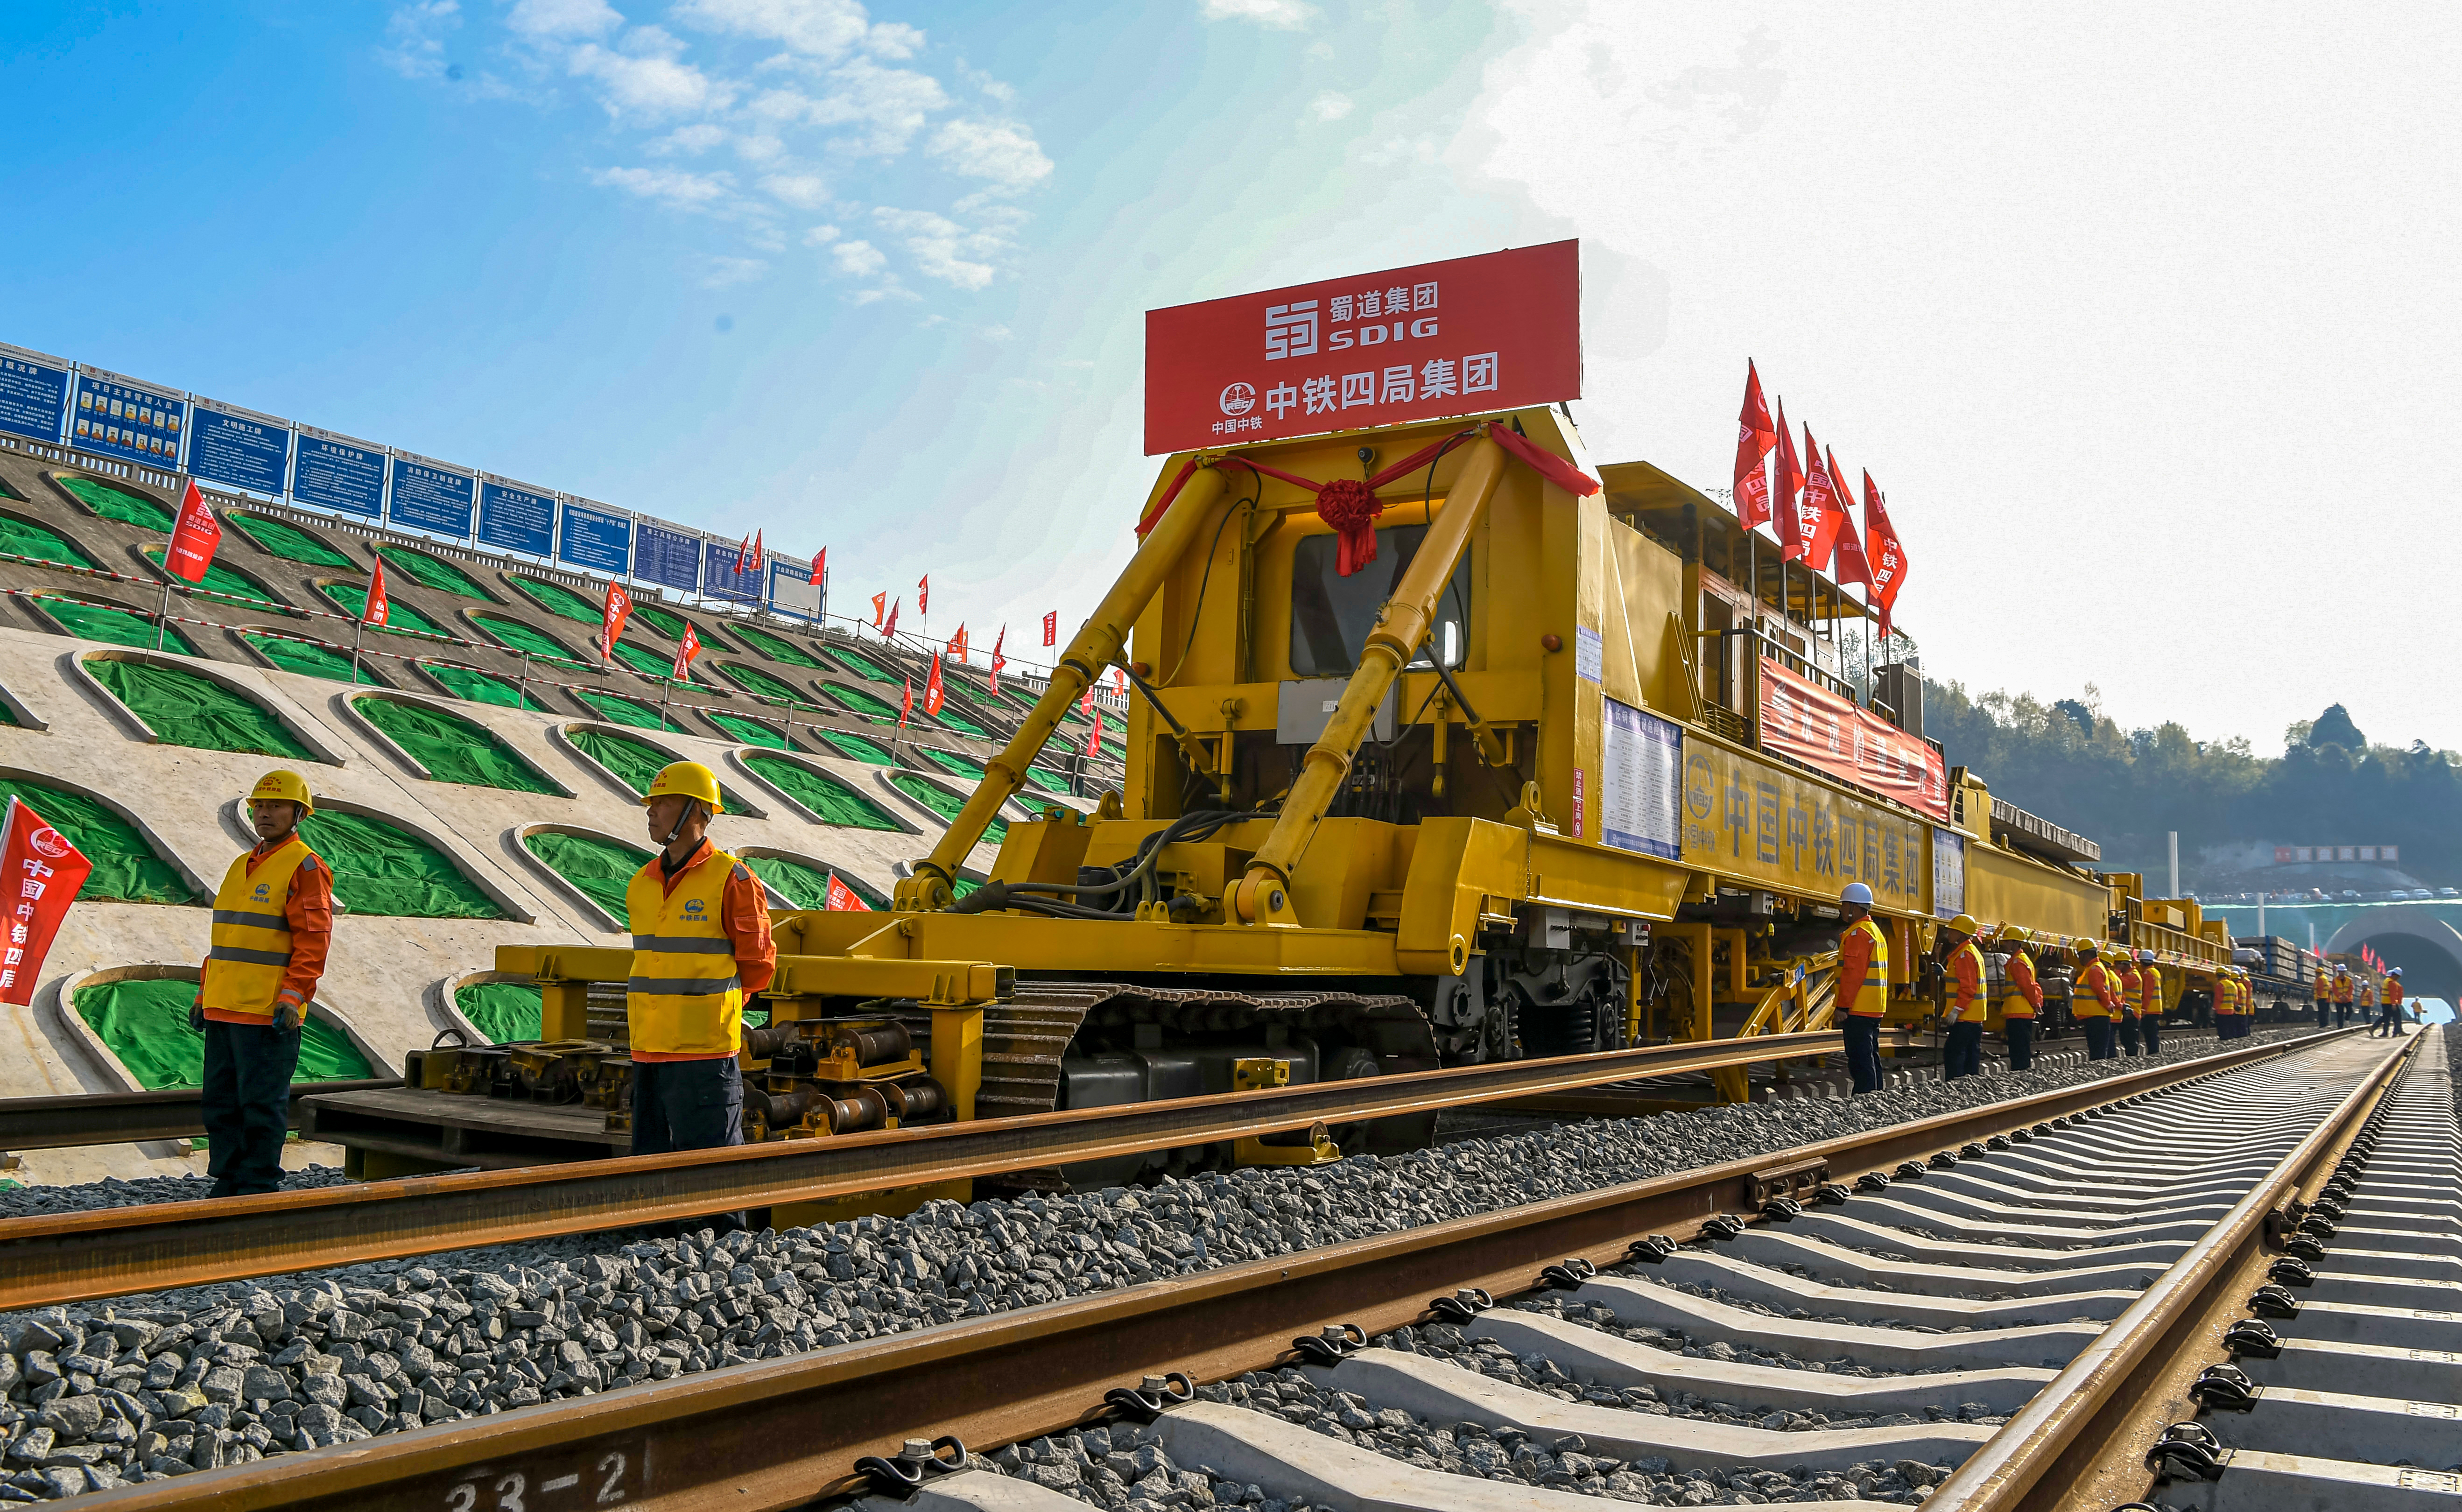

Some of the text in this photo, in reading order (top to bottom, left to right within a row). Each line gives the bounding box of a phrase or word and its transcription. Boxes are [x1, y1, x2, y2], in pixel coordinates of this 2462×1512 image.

[1330, 281, 1439, 322] 蜀道集团
[1329, 316, 1439, 352] SDIG
[91, 381, 173, 410] 项目主要管理人员
[1266, 352, 1499, 420] 中铁四局集团
[222, 419, 262, 435] 文明施工牌
[1212, 415, 1263, 435] 中国中铁
[321, 444, 363, 461] 环境保护牌
[407, 466, 462, 486] 消防保卫制度牌
[501, 490, 538, 505] 安全生产牌
[185, 520, 213, 535] SDIG
[715, 548, 751, 563] 应急预案示
[1723, 770, 1919, 898] 中国中铁四局集团
[0, 858, 55, 988] 中国中铁四局
